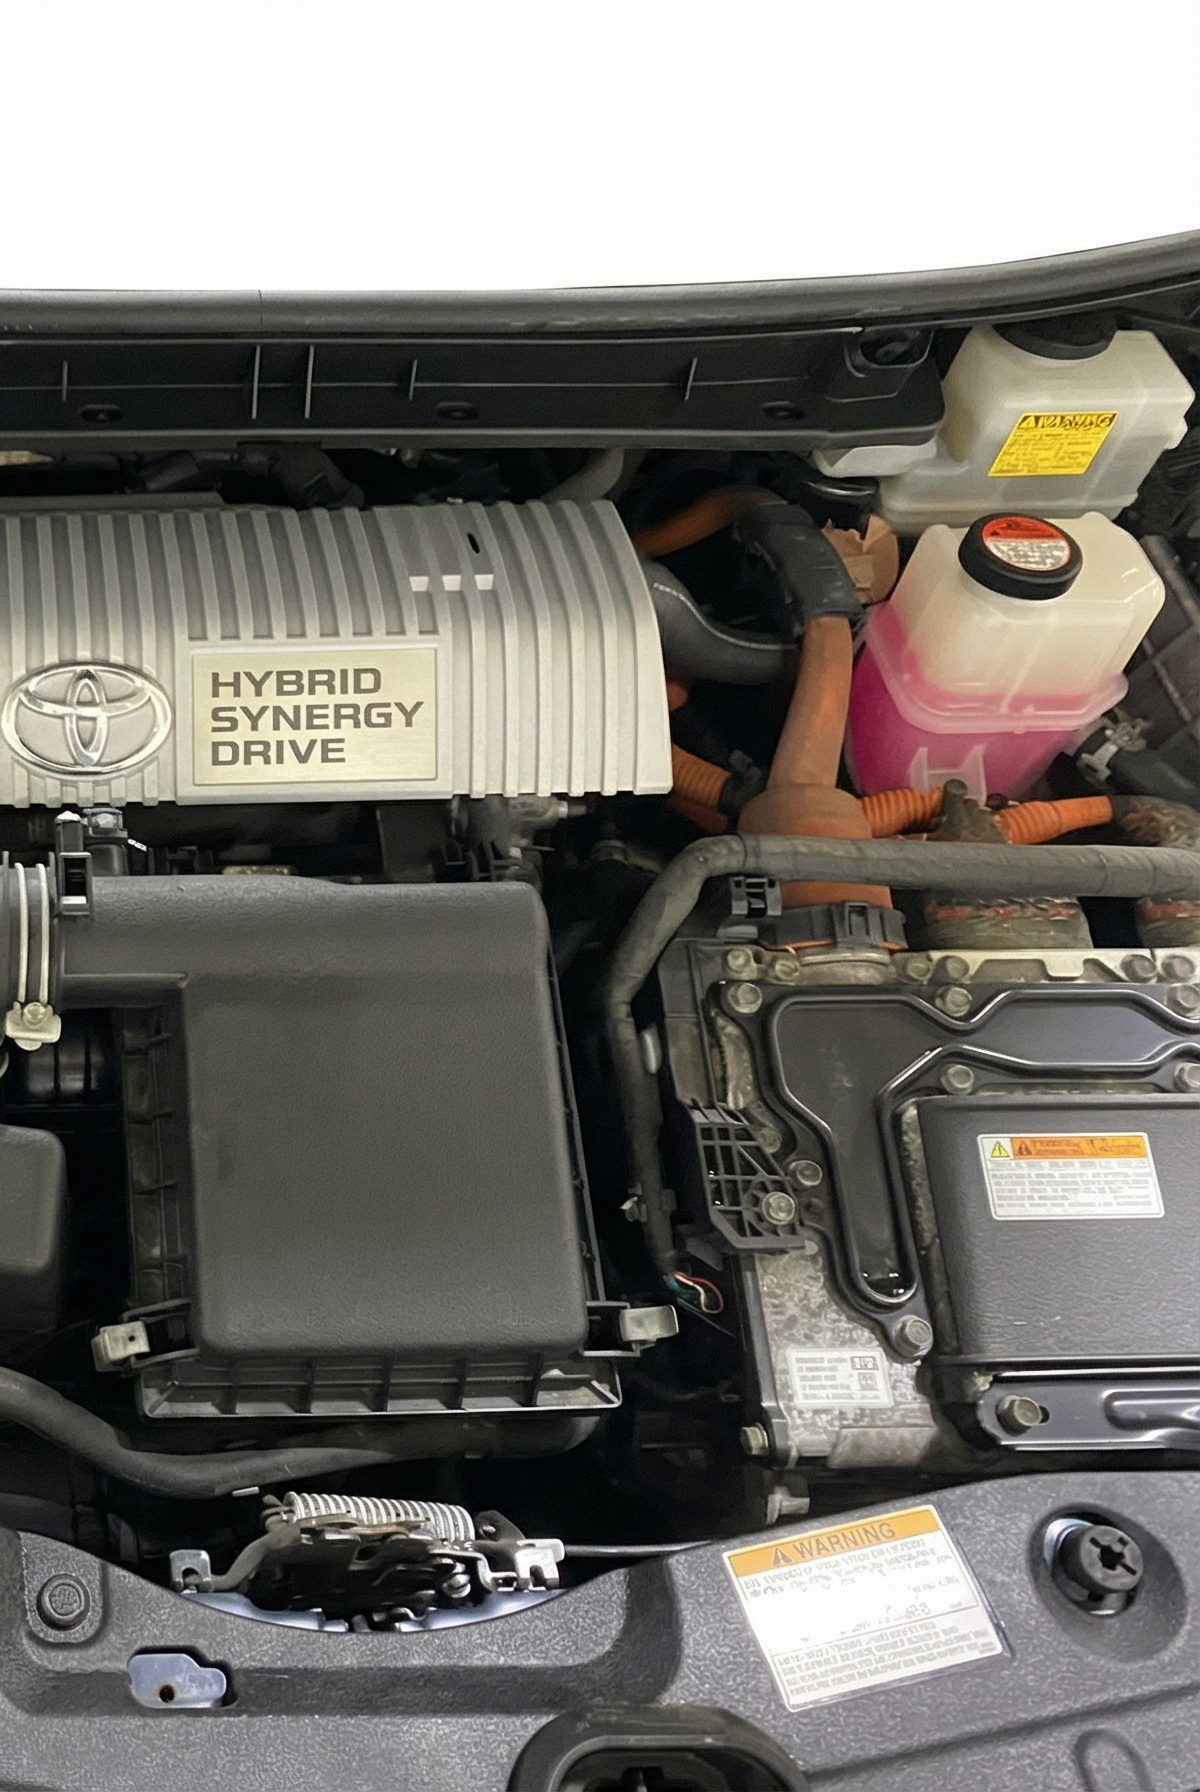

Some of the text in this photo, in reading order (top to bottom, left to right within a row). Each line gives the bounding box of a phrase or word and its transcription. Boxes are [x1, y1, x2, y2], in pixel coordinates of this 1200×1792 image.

[211, 668, 382, 698] HYBRID
[211, 701, 425, 733] SYNERGY
[211, 738, 346, 766] DRIVE
[792, 1522, 897, 1559] WARNING
